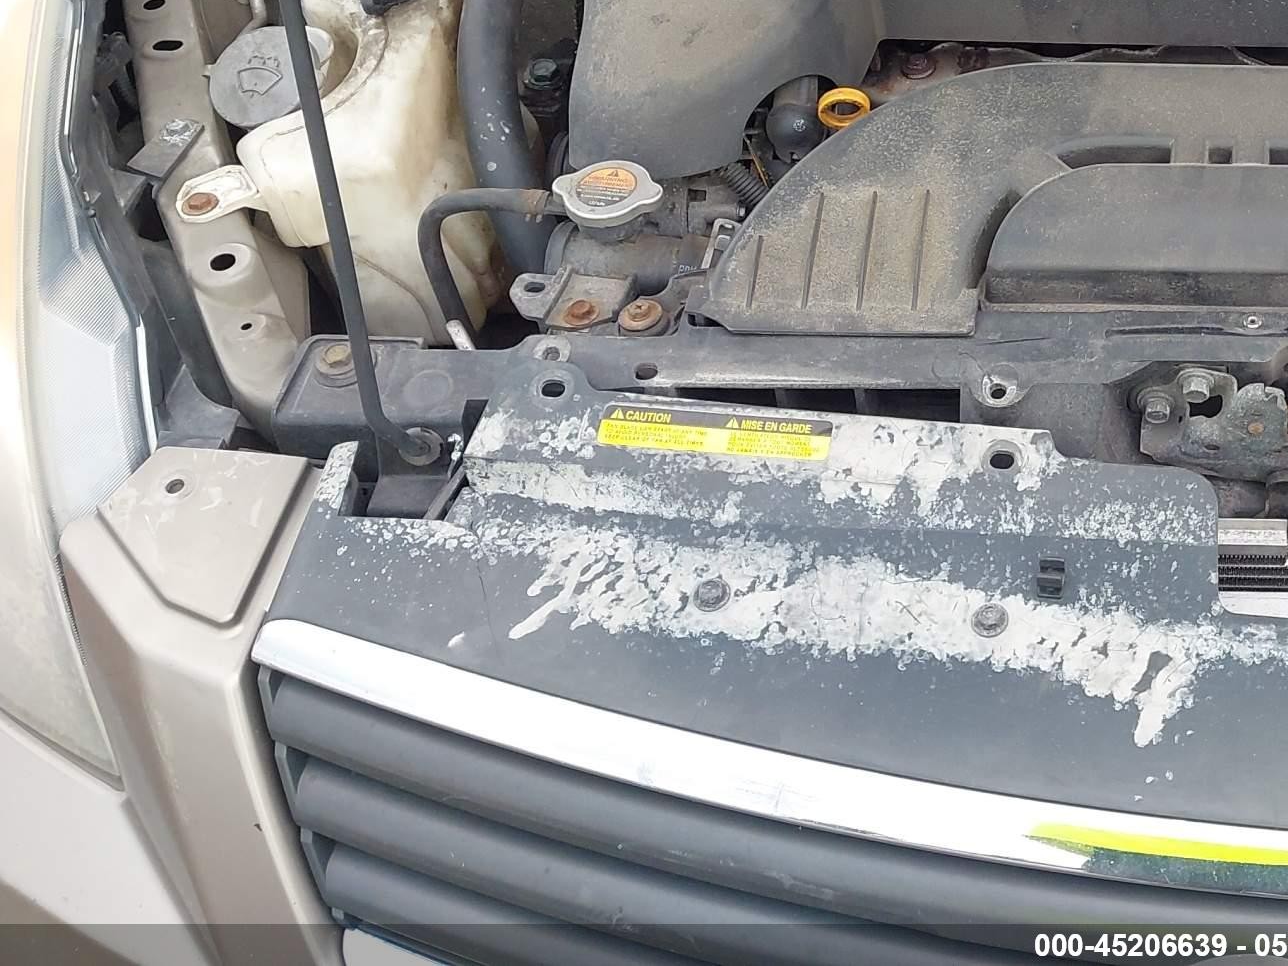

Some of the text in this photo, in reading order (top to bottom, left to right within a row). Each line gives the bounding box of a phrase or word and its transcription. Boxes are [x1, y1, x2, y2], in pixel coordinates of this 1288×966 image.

[626, 410, 672, 424] CAUTION
[741, 419, 812, 434] MISE EN GARDE
